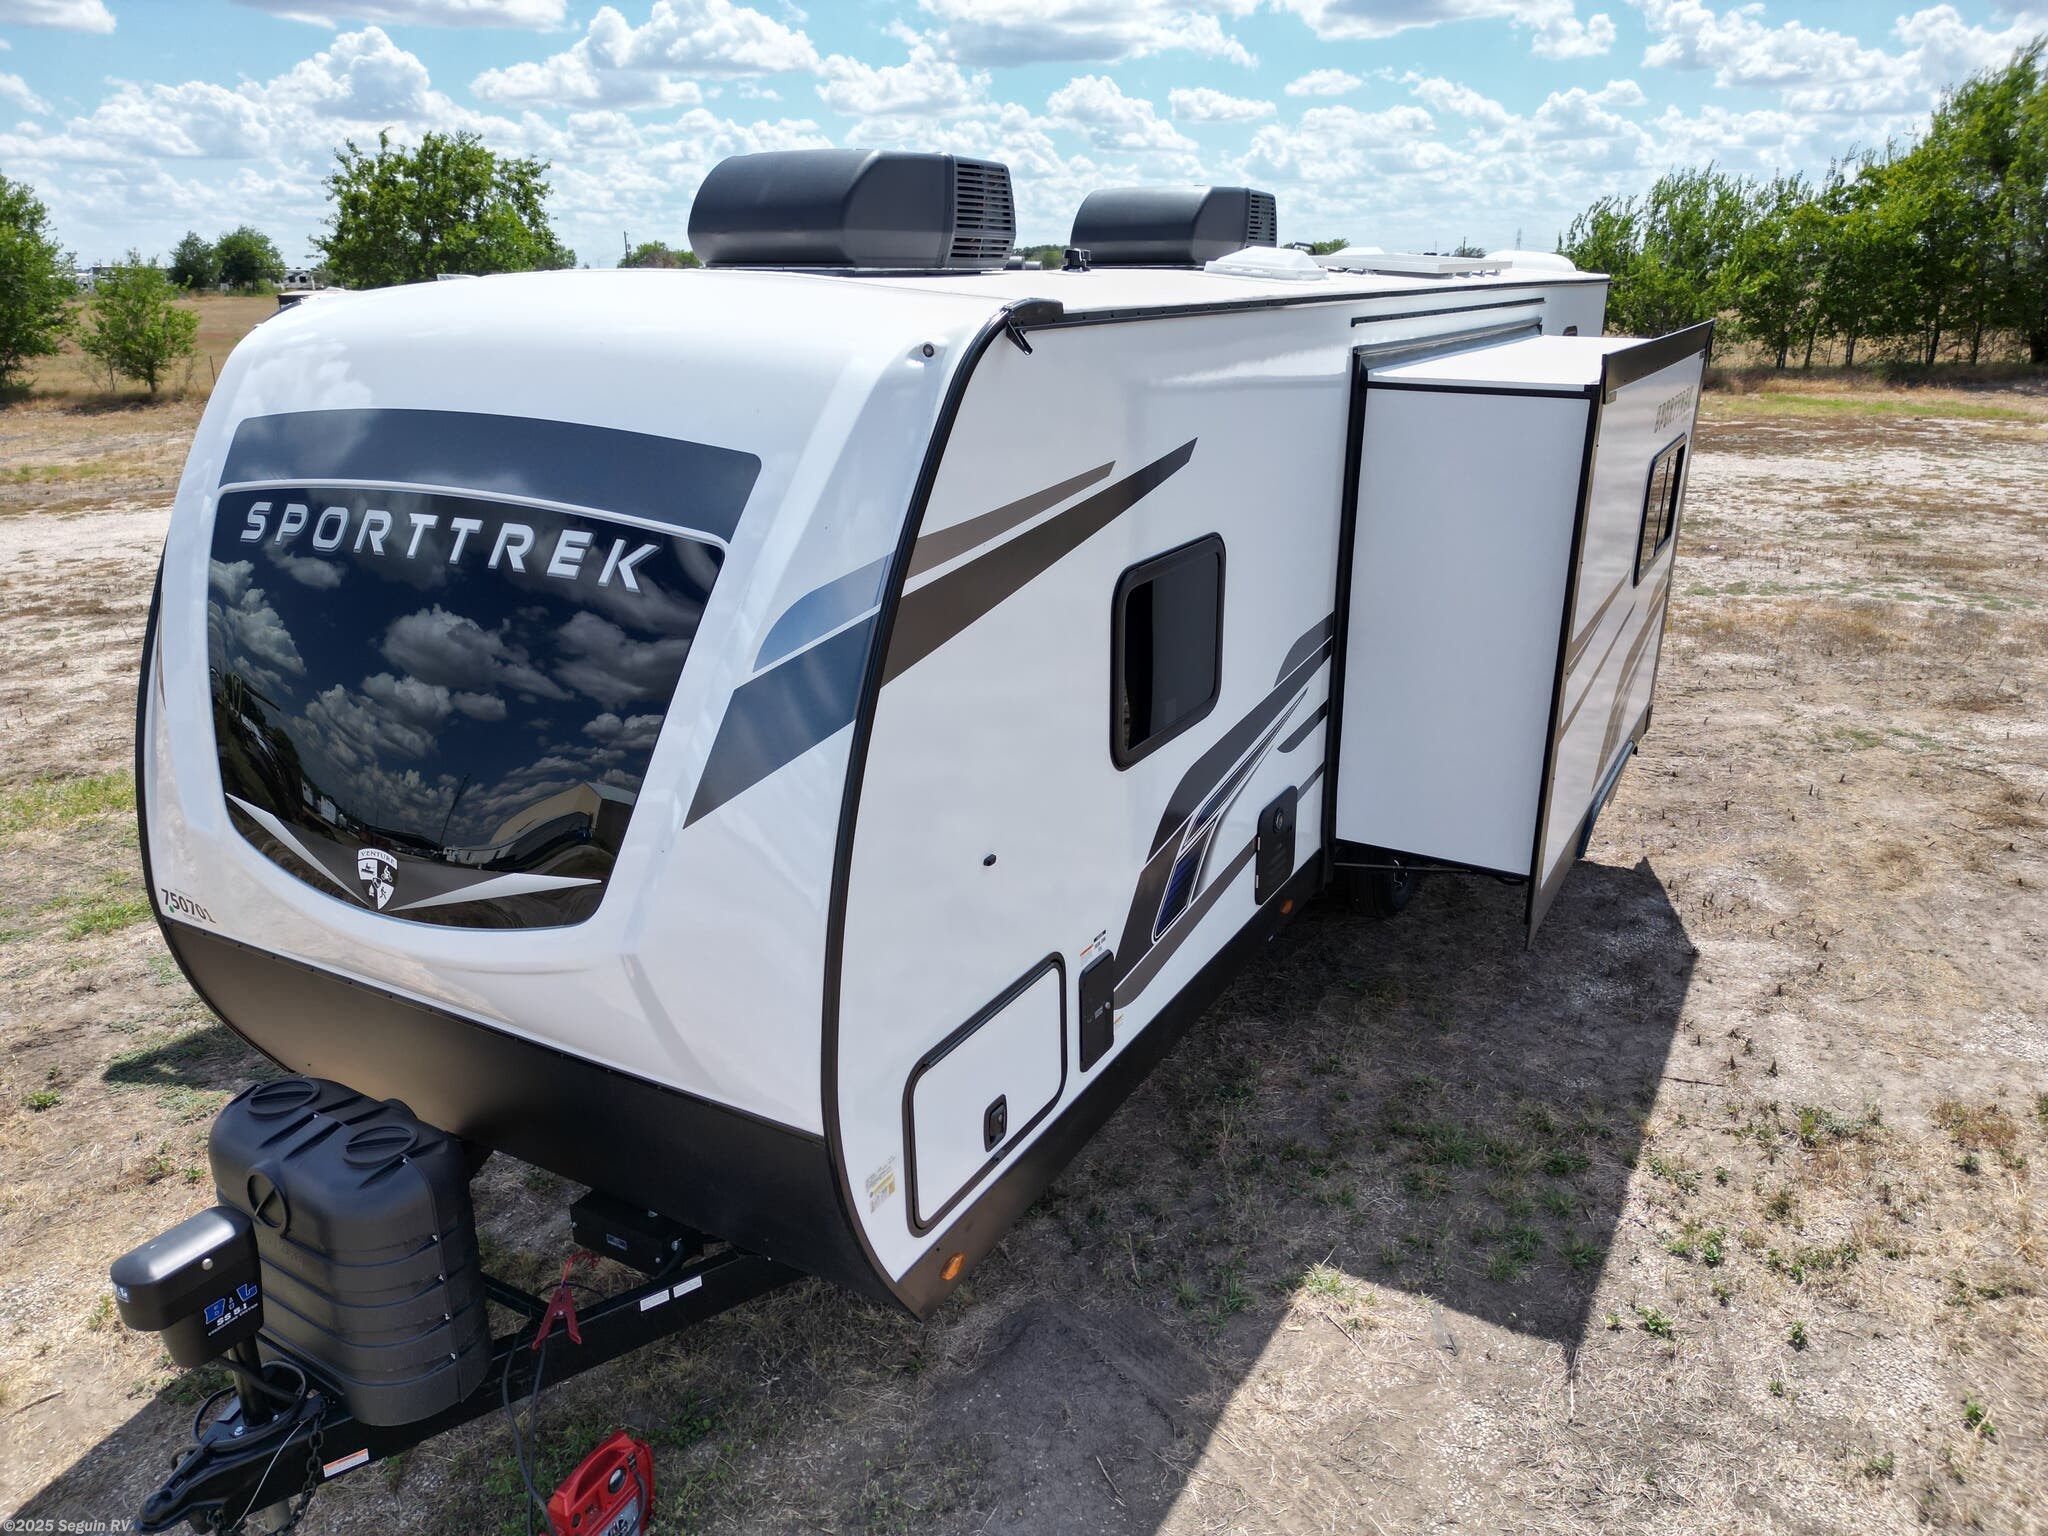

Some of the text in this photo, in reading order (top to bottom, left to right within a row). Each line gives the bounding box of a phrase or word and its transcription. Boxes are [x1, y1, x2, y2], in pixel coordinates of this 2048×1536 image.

[240, 501, 660, 593] SPORTTREK
[360, 850, 395, 864] VENTURE
[161, 888, 217, 924] 750701
